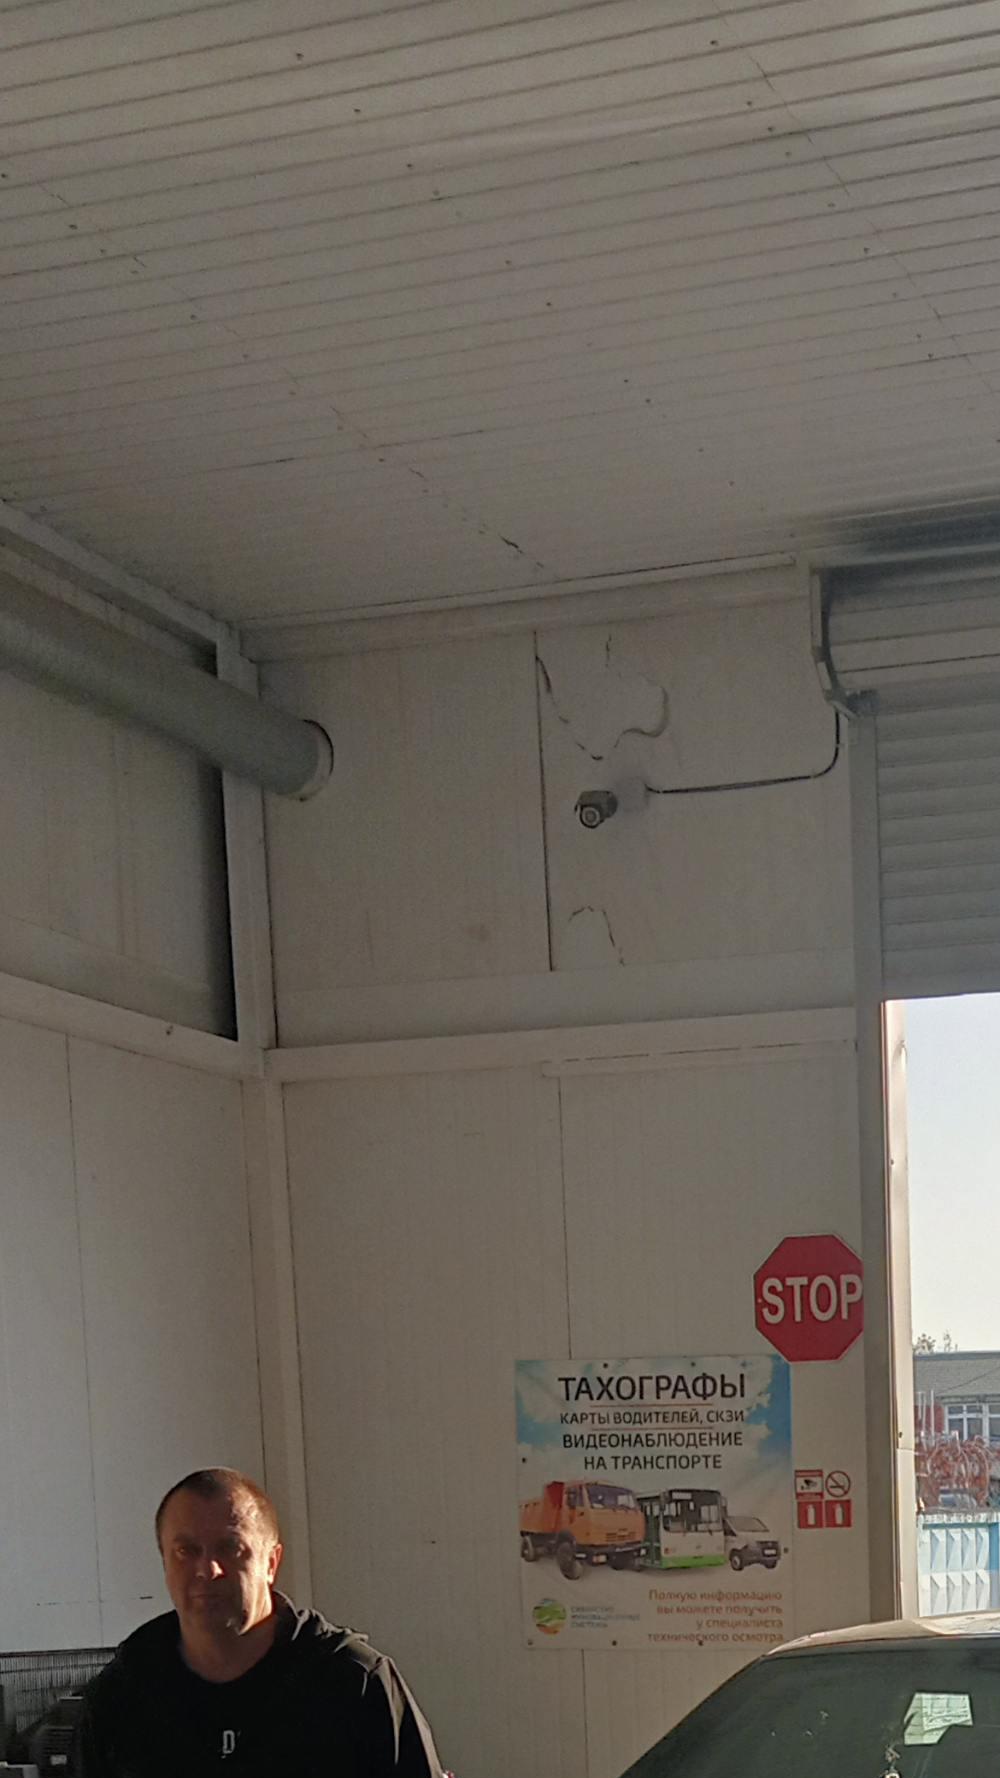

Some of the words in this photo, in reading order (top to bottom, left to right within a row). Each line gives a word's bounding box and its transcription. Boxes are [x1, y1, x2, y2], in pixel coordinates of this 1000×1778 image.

[762, 1274, 863, 1324] STOP
[558, 1373, 745, 1400] ТАХОГРАФЫ
[560, 1412, 610, 1425] КАРТЫ
[614, 1409, 703, 1426] ВОДИТЕЛЕЙ,
[706, 1410, 745, 1423] СКЗИ
[563, 1432, 743, 1449] ВИДЕОНАБЛЮДЕНИЕ
[584, 1456, 607, 1470] НА
[611, 1454, 722, 1470] ТРАНСПОРТЕ
[700, 1589, 783, 1603] информацию
[726, 1605, 783, 1616] получить
[705, 1619, 783, 1629] специалиста
[732, 1633, 784, 1643] осмотра
